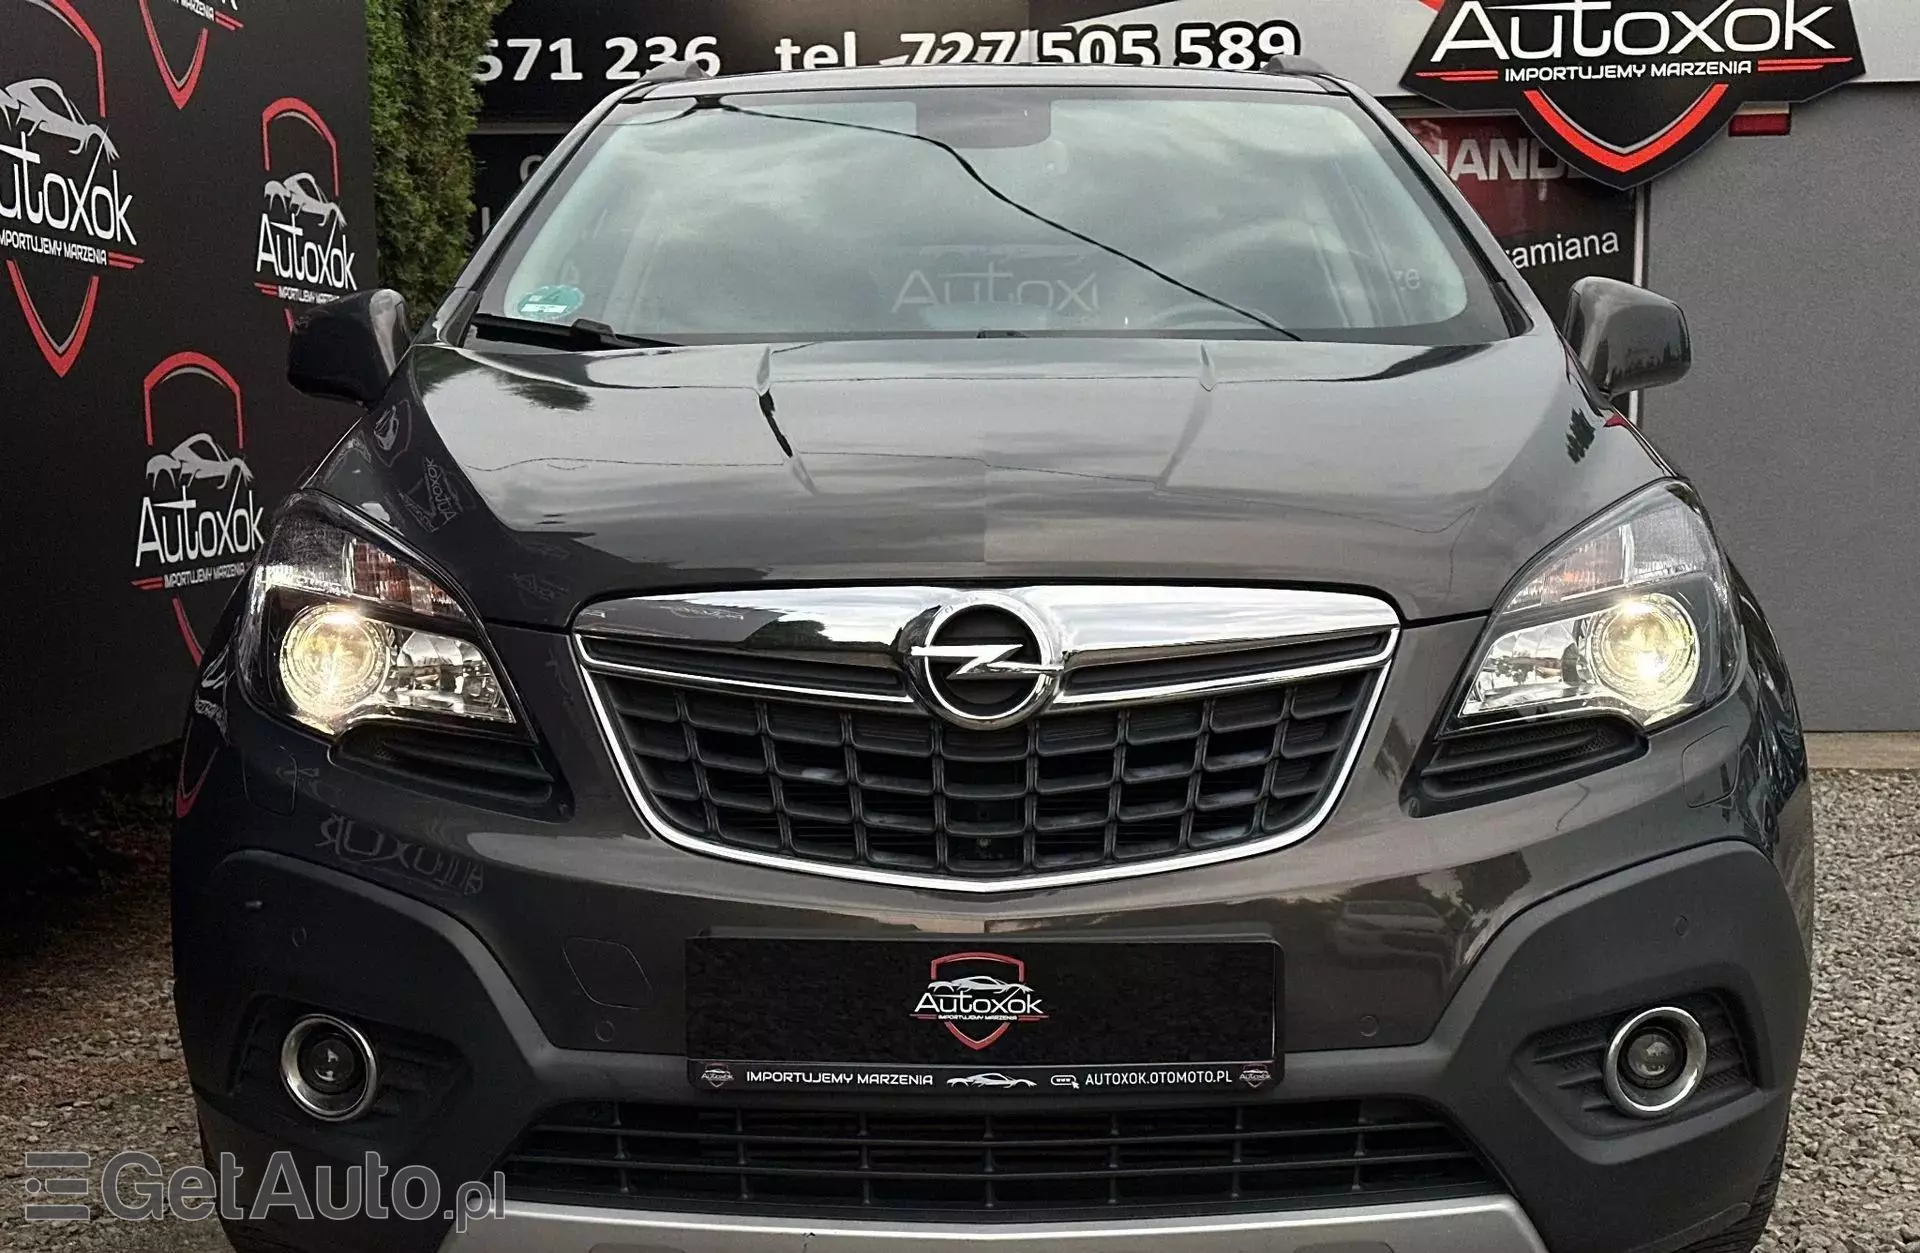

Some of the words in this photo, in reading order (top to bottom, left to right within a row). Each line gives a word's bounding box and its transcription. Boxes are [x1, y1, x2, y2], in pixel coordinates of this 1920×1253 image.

[1430, 0, 1835, 62] Autoxok
[605, 36, 720, 80] 236
[1041, 30, 1156, 66] 505
[1179, 26, 1295, 70] 589
[1504, 62, 1645, 82] IMPORTUJEMY
[1650, 60, 1752, 77] MARZENIA
[1432, 137, 1595, 181] HAND
[0, 126, 137, 246] utoxok
[0, 228, 62, 257] MPORTUJEMY
[63, 242, 107, 266] MARZENIA
[256, 213, 357, 291] Autoxok
[1506, 231, 1620, 269] amiana
[135, 471, 265, 568] Autoxok
[914, 986, 1045, 1014] Autoxok
[746, 1071, 855, 1085] IMPORTUJEMY
[857, 1073, 934, 1086] MARZENIA
[1085, 1070, 1233, 1087] AUTOXOK.OTOMOTO.PL
